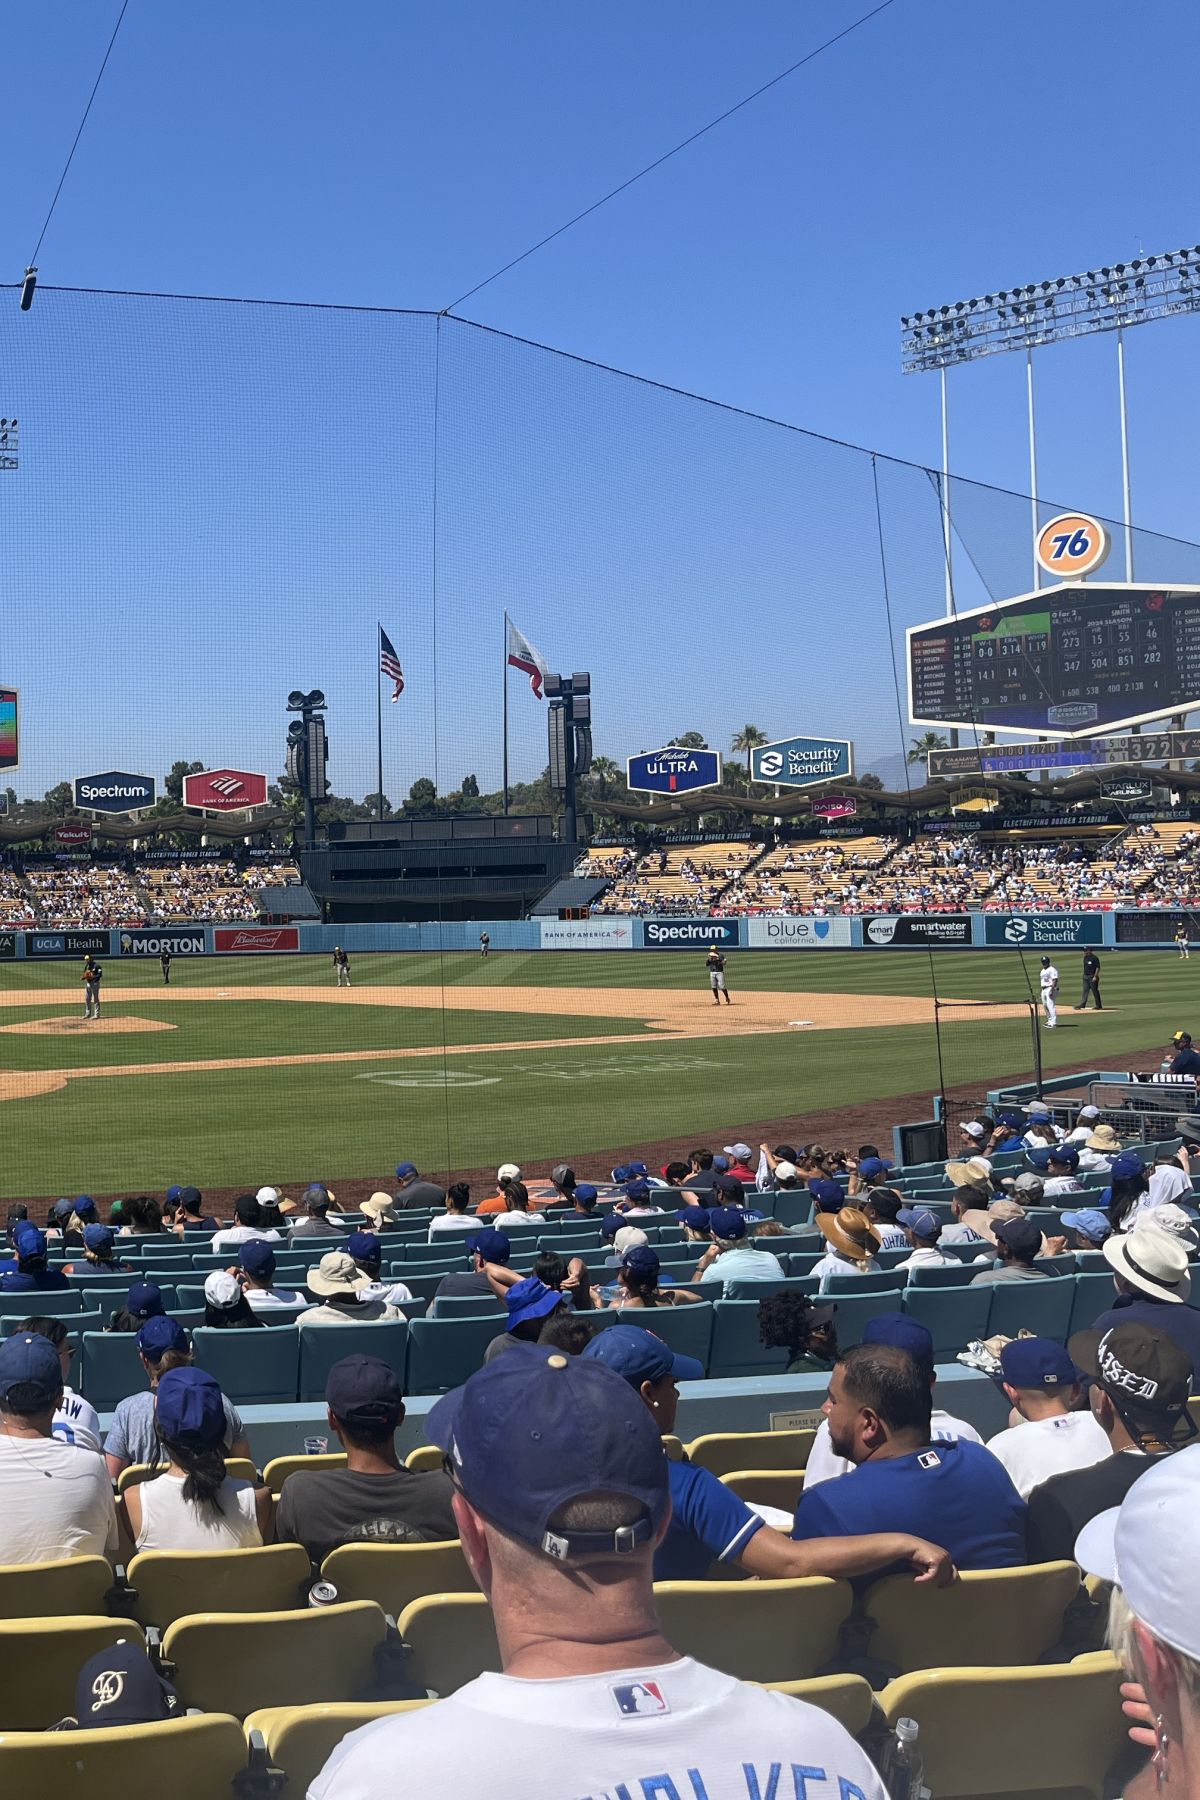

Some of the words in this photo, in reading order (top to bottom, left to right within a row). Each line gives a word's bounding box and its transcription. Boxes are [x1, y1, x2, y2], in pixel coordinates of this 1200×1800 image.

[1050, 527, 1091, 560] 76
[1105, 617, 1132, 625] SEASON
[1119, 632, 1130, 642] 55
[1146, 629, 1157, 639] 46
[1092, 635, 1102, 645] 15
[1144, 653, 1161, 664] 282
[788, 747, 841, 762] Security
[1132, 743, 1141, 760] 3
[1146, 742, 1156, 759] 2
[1160, 741, 1170, 757] 2
[654, 751, 689, 762] Michelob
[647, 760, 699, 775] ULTRA
[788, 760, 834, 774] Benefit
[1104, 782, 1149, 790] STARLUX
[80, 785, 146, 800] Spectrum
[1110, 788, 1142, 796] AIRLINES
[1003, 818, 1049, 828] ELECTRIFYING
[1051, 817, 1076, 825] DODGER
[1079, 815, 1109, 823] STADIUM
[57, 831, 89, 839] Yakult
[665, 834, 703, 843] ELECTRIFYING
[767, 920, 809, 936] blue
[868, 926, 894, 934] smart
[910, 922, 967, 931] smartwater
[1032, 918, 1082, 931] Security
[648, 924, 725, 942] Spectrum
[1033, 931, 1076, 942] Benefit
[36, 939, 62, 949] UCLA
[68, 938, 103, 949] Health
[237, 935, 277, 944] Budweiser
[774, 936, 815, 944] california
[132, 938, 204, 954] MORTON
